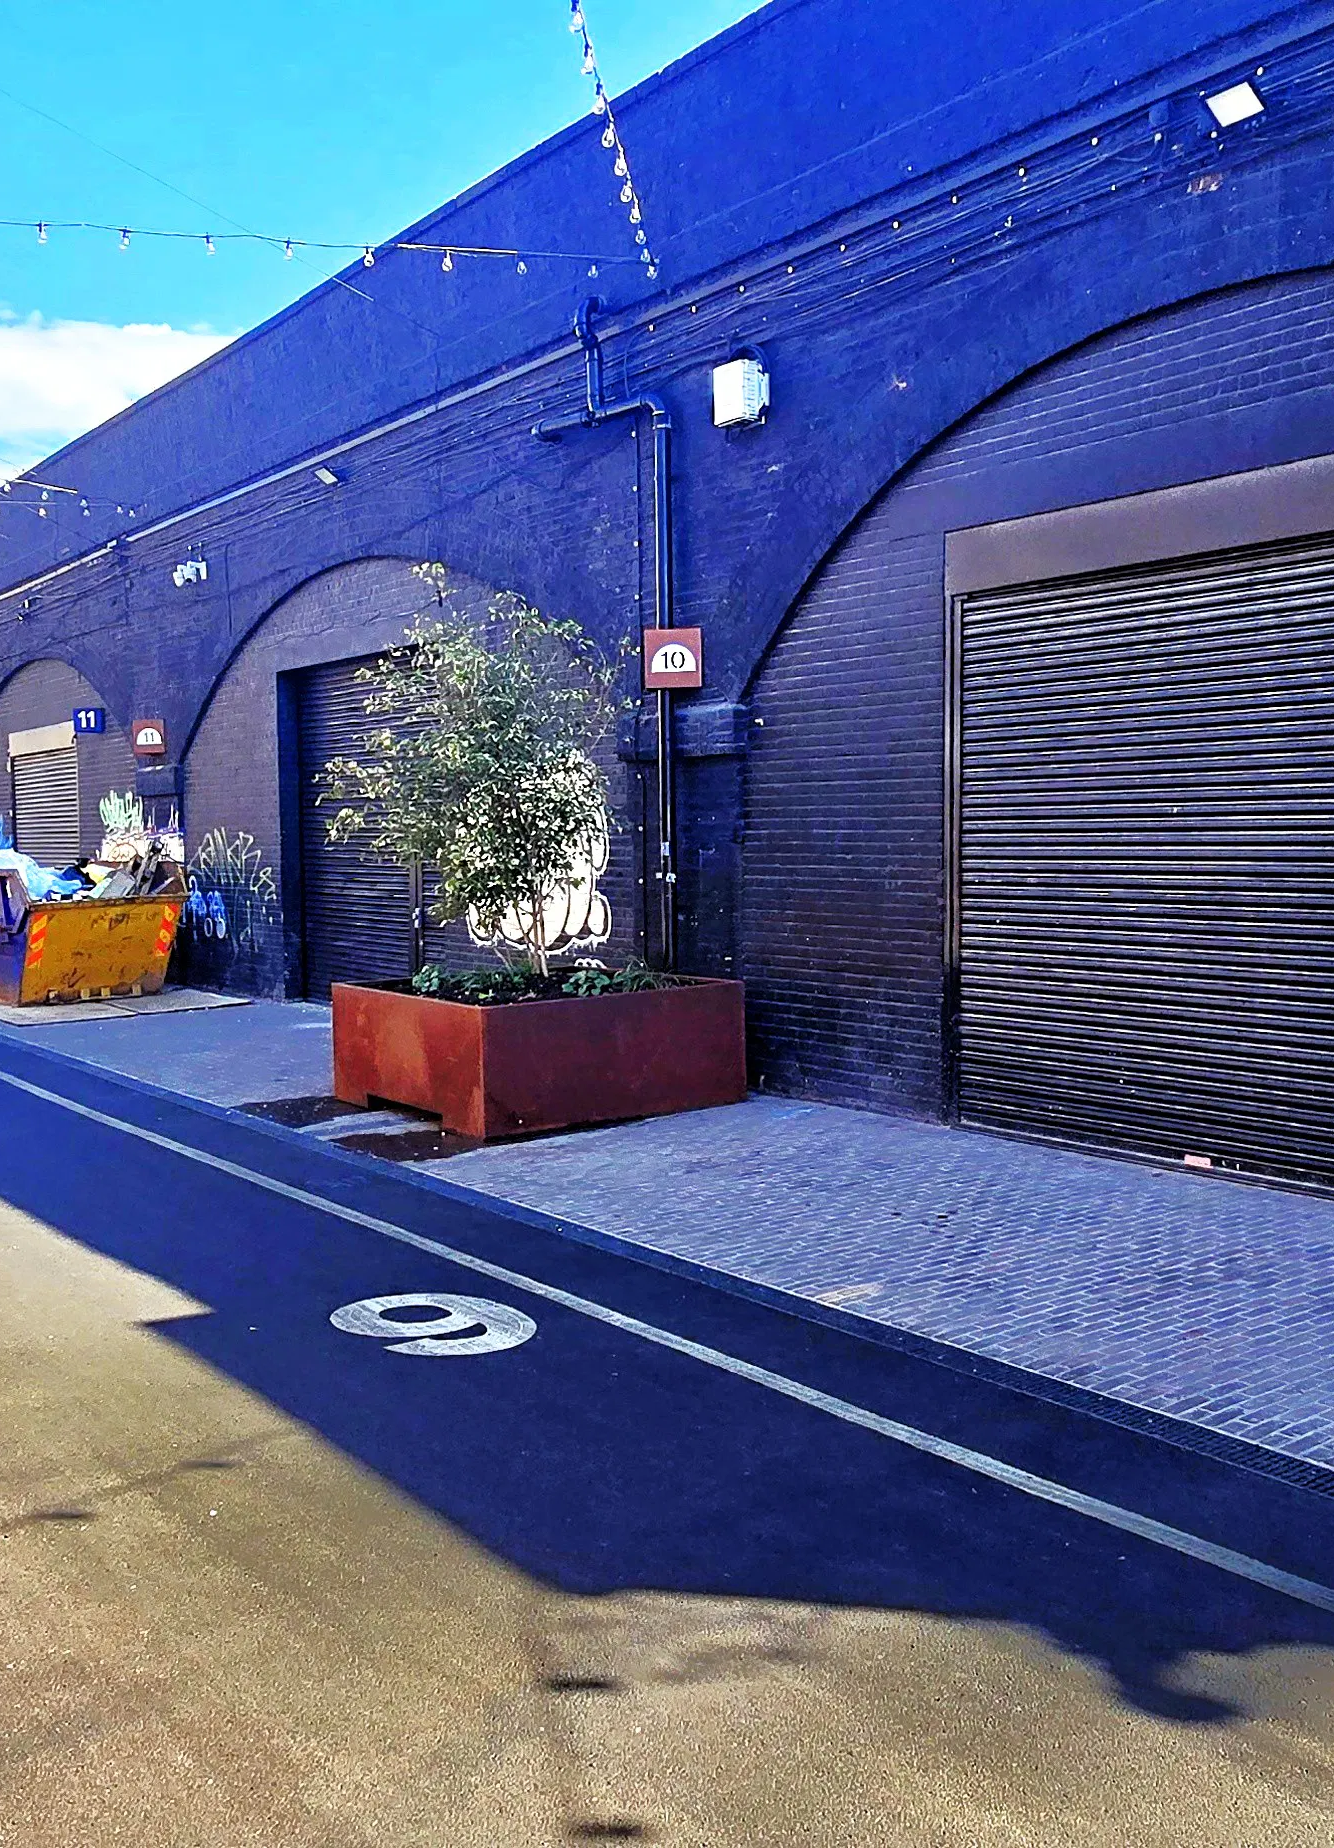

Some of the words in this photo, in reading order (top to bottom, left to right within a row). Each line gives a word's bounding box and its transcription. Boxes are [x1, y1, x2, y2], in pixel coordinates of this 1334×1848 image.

[660, 651, 686, 669] 10
[77, 710, 96, 729] 11
[144, 732, 155, 743] 11
[329, 1292, 538, 1357] 9
